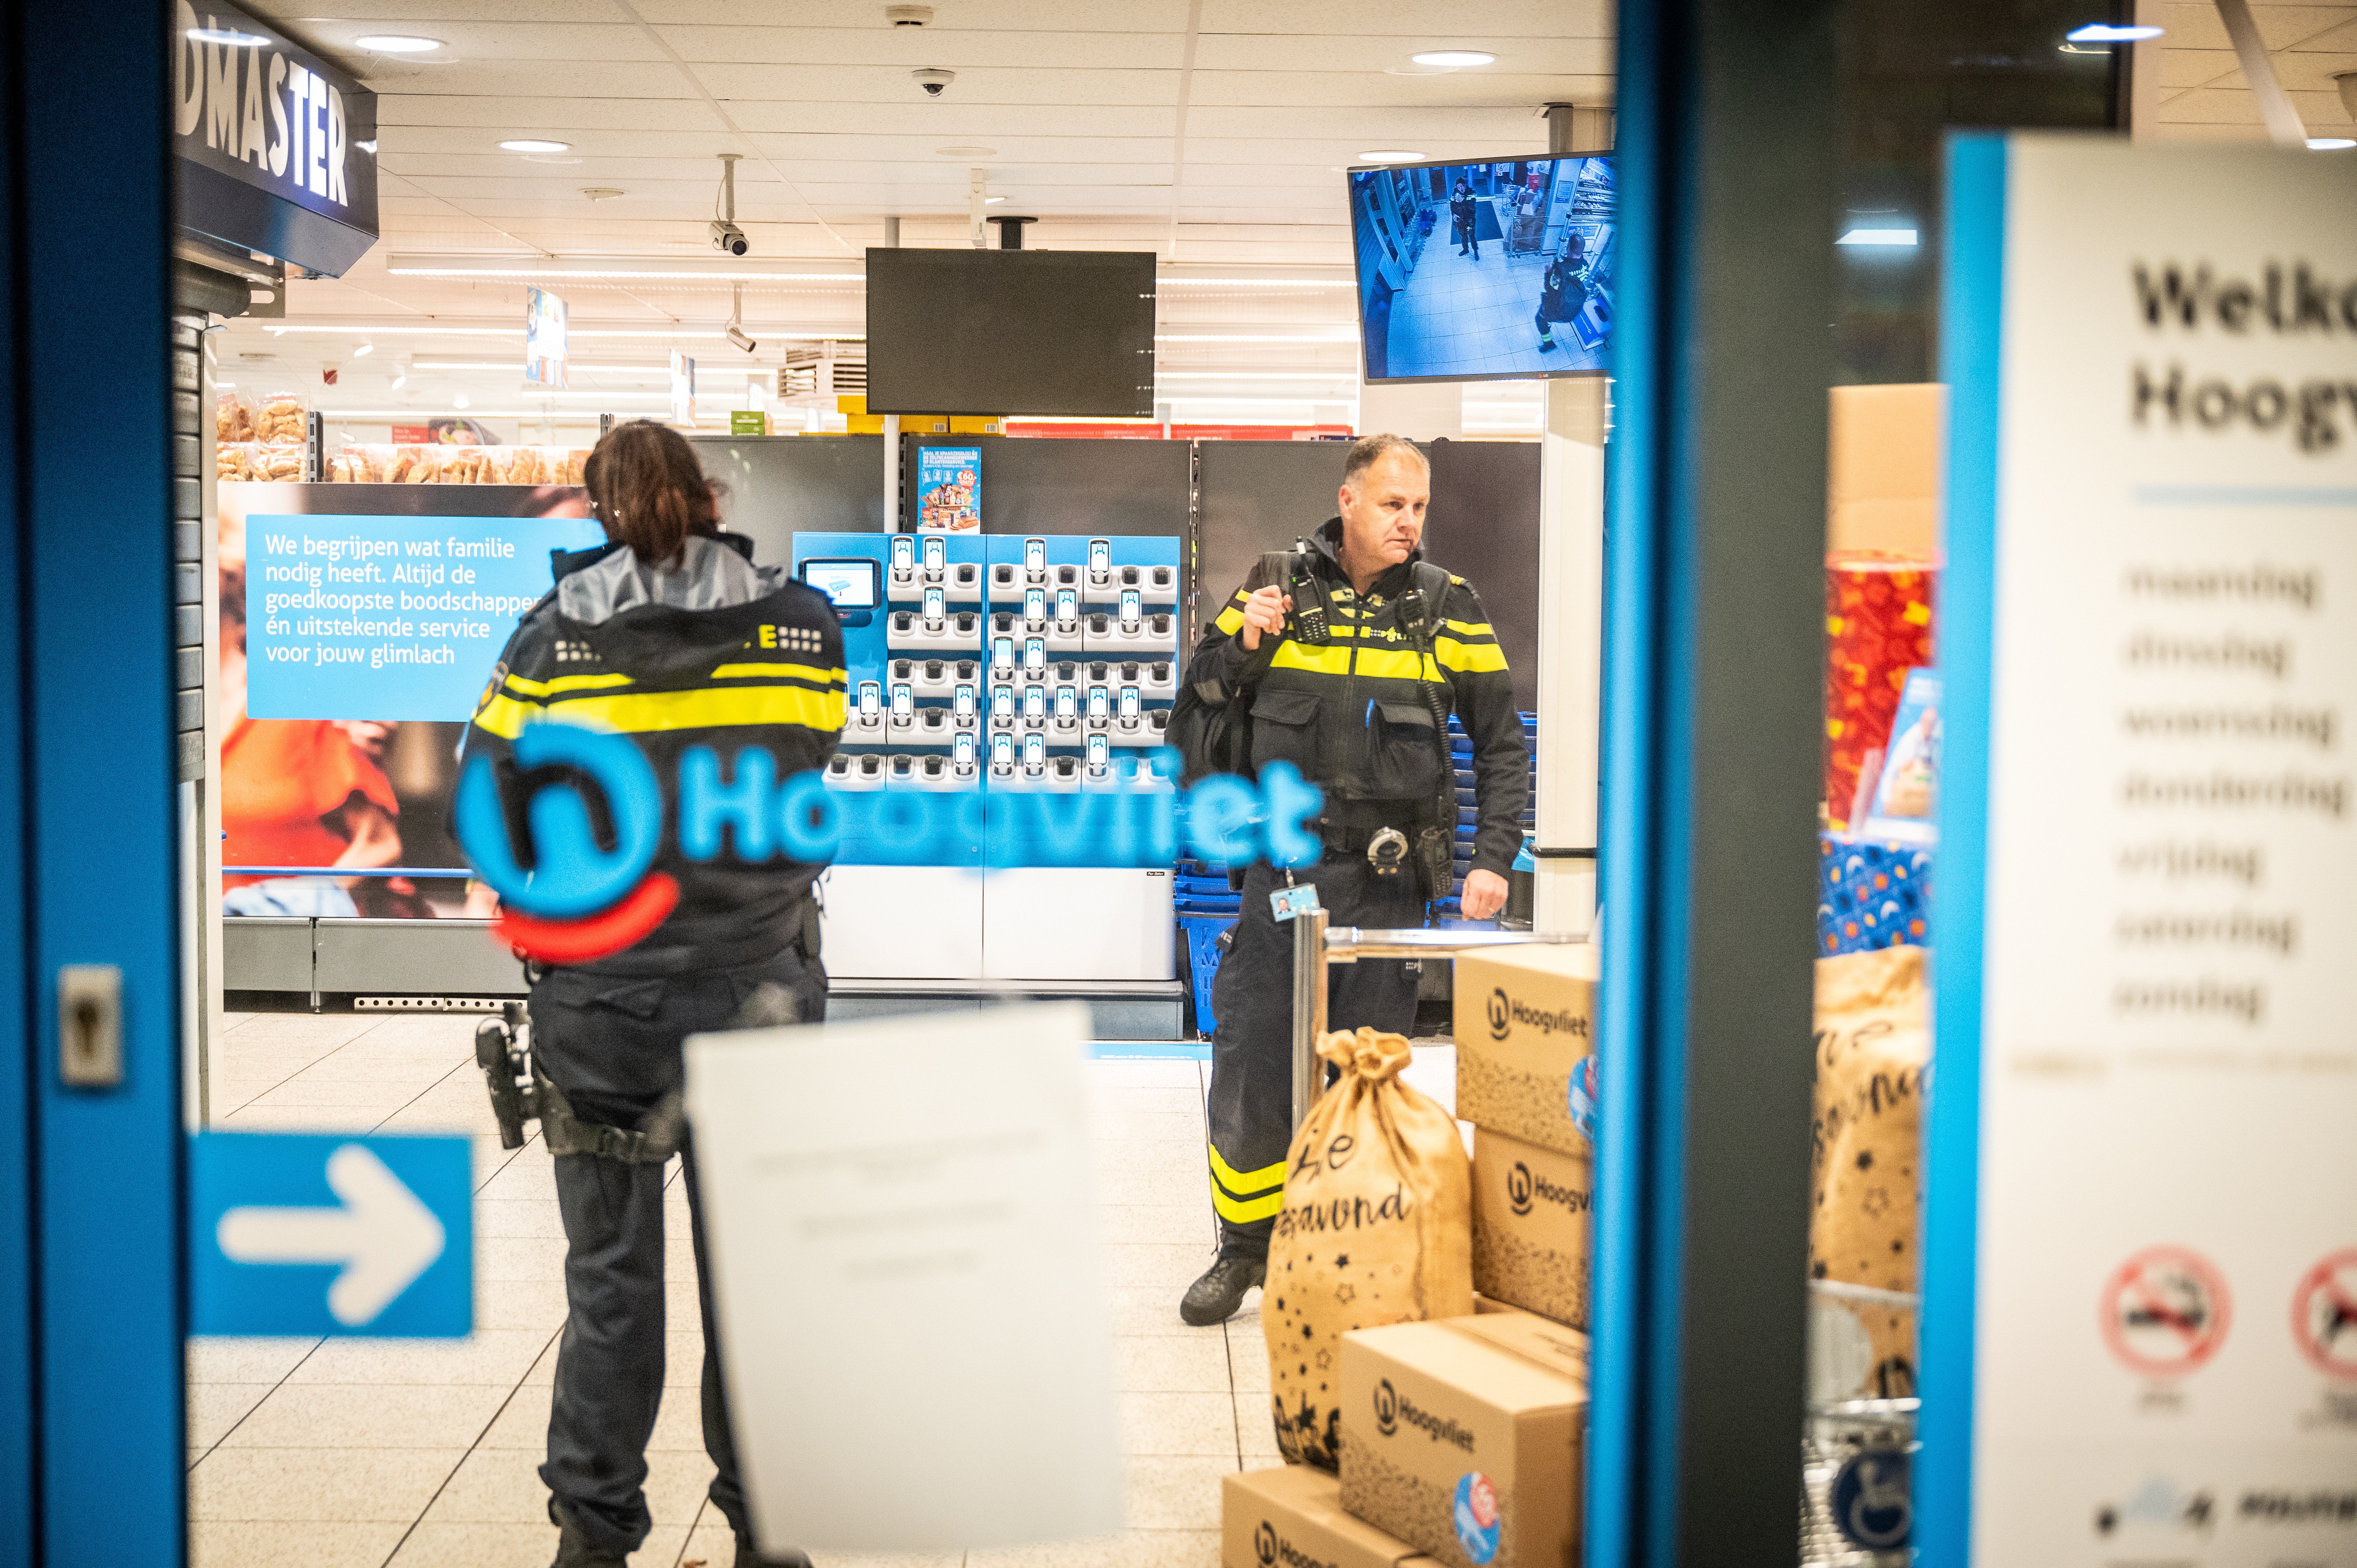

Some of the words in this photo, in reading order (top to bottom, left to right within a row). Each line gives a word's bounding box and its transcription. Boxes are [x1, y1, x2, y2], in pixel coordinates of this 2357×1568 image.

[175, 0, 348, 207] DMASTER
[265, 534, 298, 555] We
[304, 534, 399, 562] begrijpen
[405, 539, 442, 557] wat
[446, 536, 515, 558] familie
[266, 561, 323, 588] nodig
[328, 562, 386, 583] heeft.
[392, 563, 444, 588] Altijd
[451, 564, 476, 584] de
[265, 588, 394, 615] goedkoopste
[266, 615, 290, 635] én
[297, 615, 413, 637] uitstekende
[419, 617, 491, 638] service
[265, 646, 311, 662] voor
[315, 642, 365, 666] jouw
[371, 643, 455, 669] glimlach
[676, 744, 1326, 875] Hoogvliet
[1535, 1174, 1591, 1213] Hoogv
